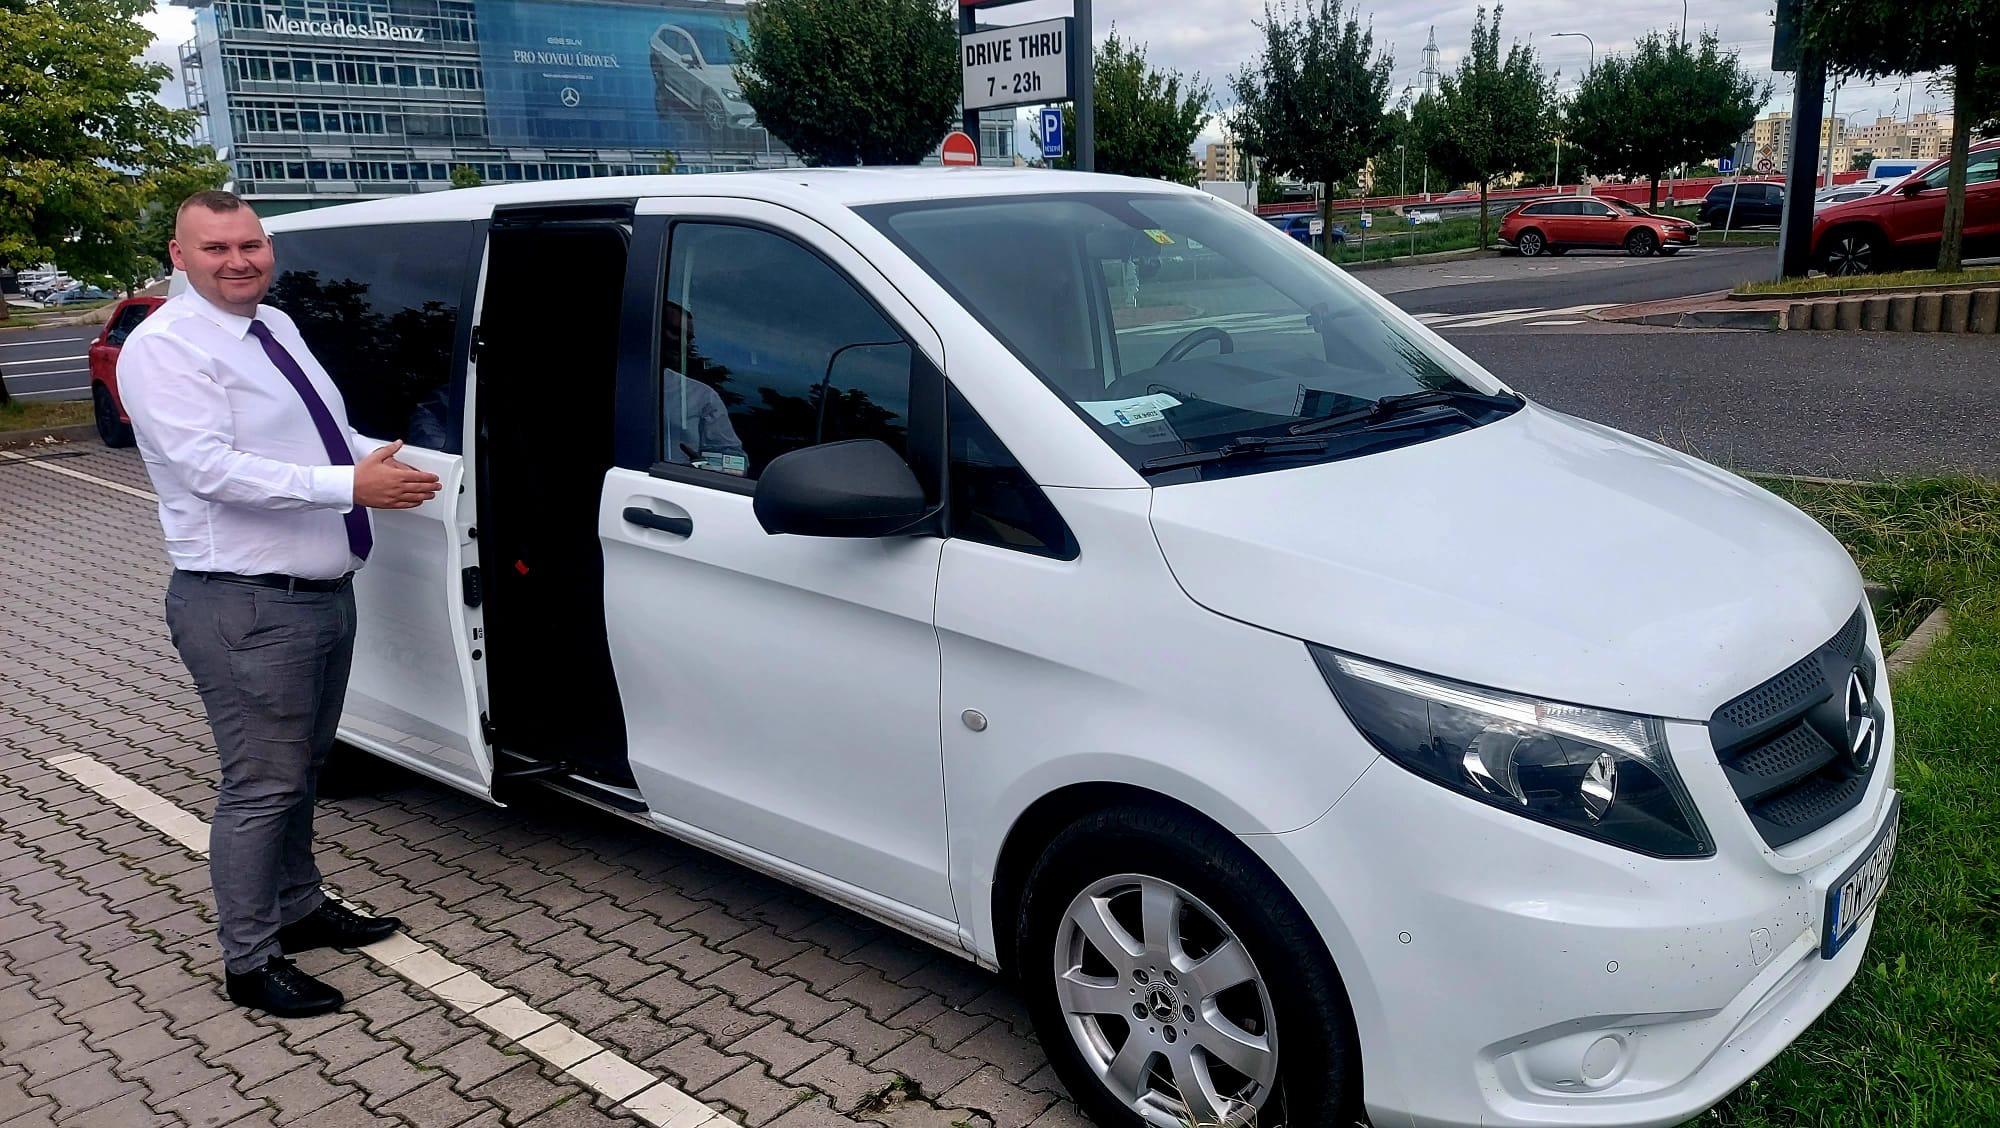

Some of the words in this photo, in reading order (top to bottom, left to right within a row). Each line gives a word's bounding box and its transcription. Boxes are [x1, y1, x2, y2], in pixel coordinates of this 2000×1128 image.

[266, 13, 425, 42] Mercedes-Benz
[513, 50, 535, 64] PRO
[537, 51, 573, 66] NOVOU
[966, 39, 1012, 67] DRIVE
[1019, 31, 1062, 59] THRU
[987, 77, 996, 97] 7
[1013, 71, 1041, 94] 23h
[1045, 114, 1058, 143] P
